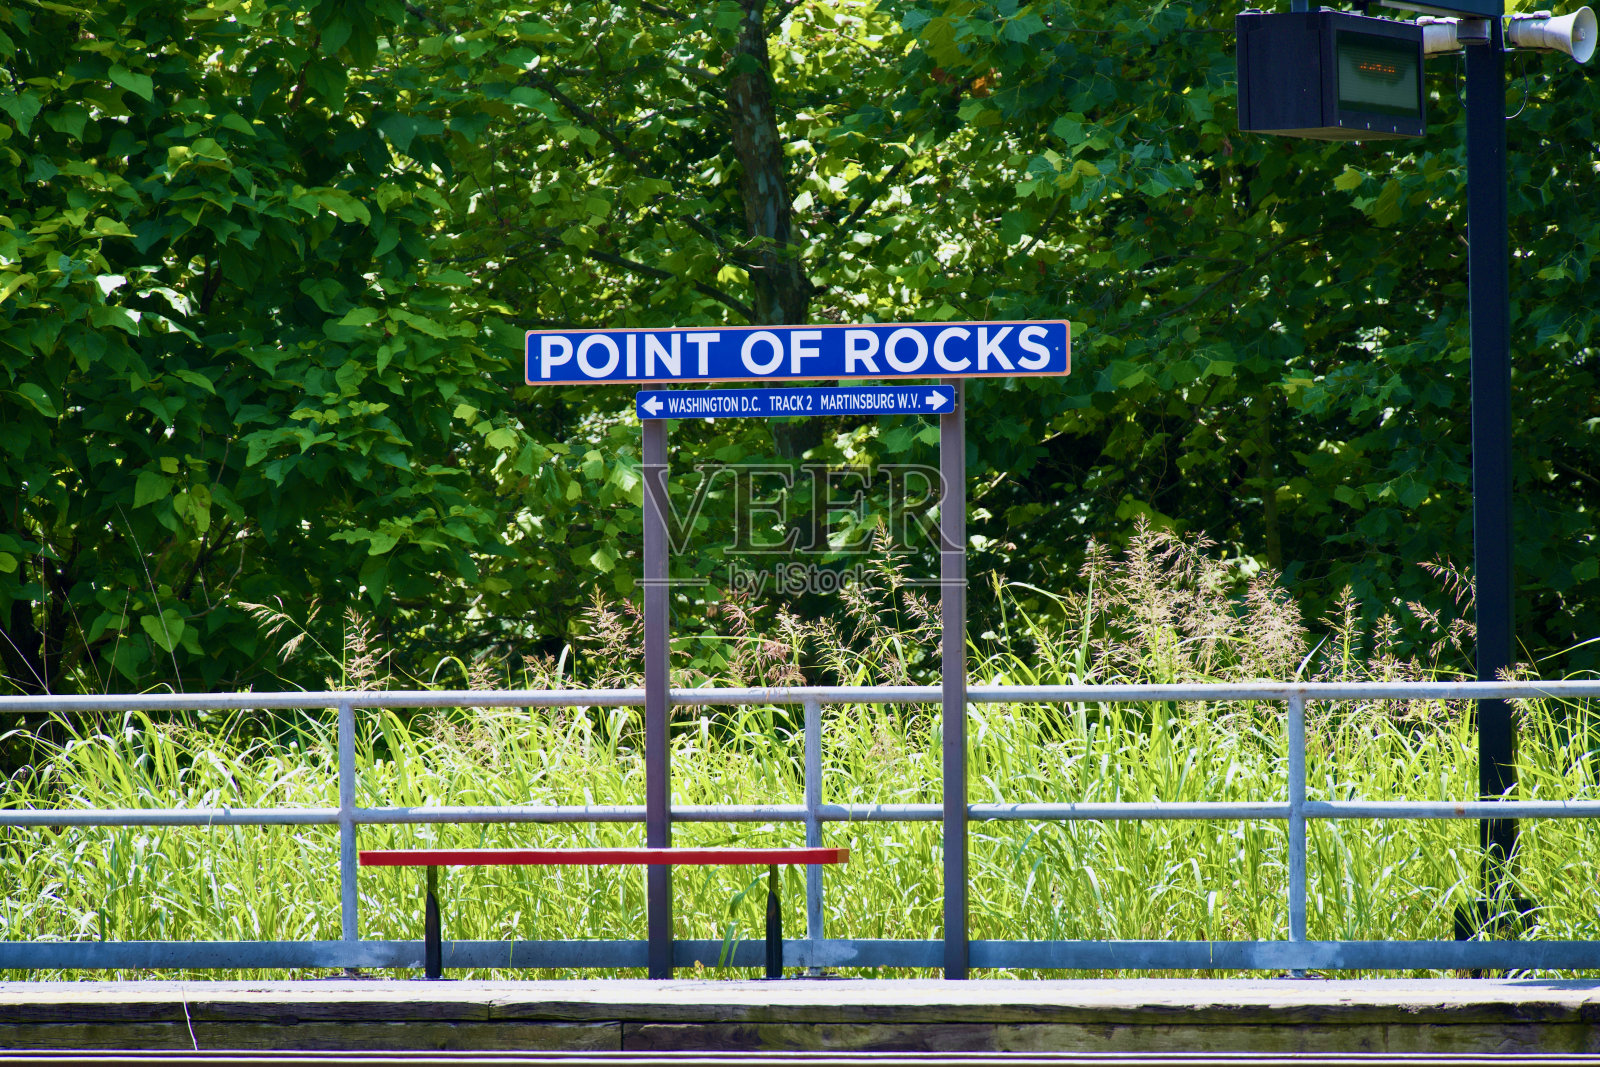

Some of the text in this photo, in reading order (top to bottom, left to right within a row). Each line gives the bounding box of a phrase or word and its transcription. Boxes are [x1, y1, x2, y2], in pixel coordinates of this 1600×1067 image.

[540, 326, 1051, 379] POINT OF ROCKS
[668, 393, 921, 413] WASHINGTON D.C. TRACK 2 MARTINSBURG W.V.
